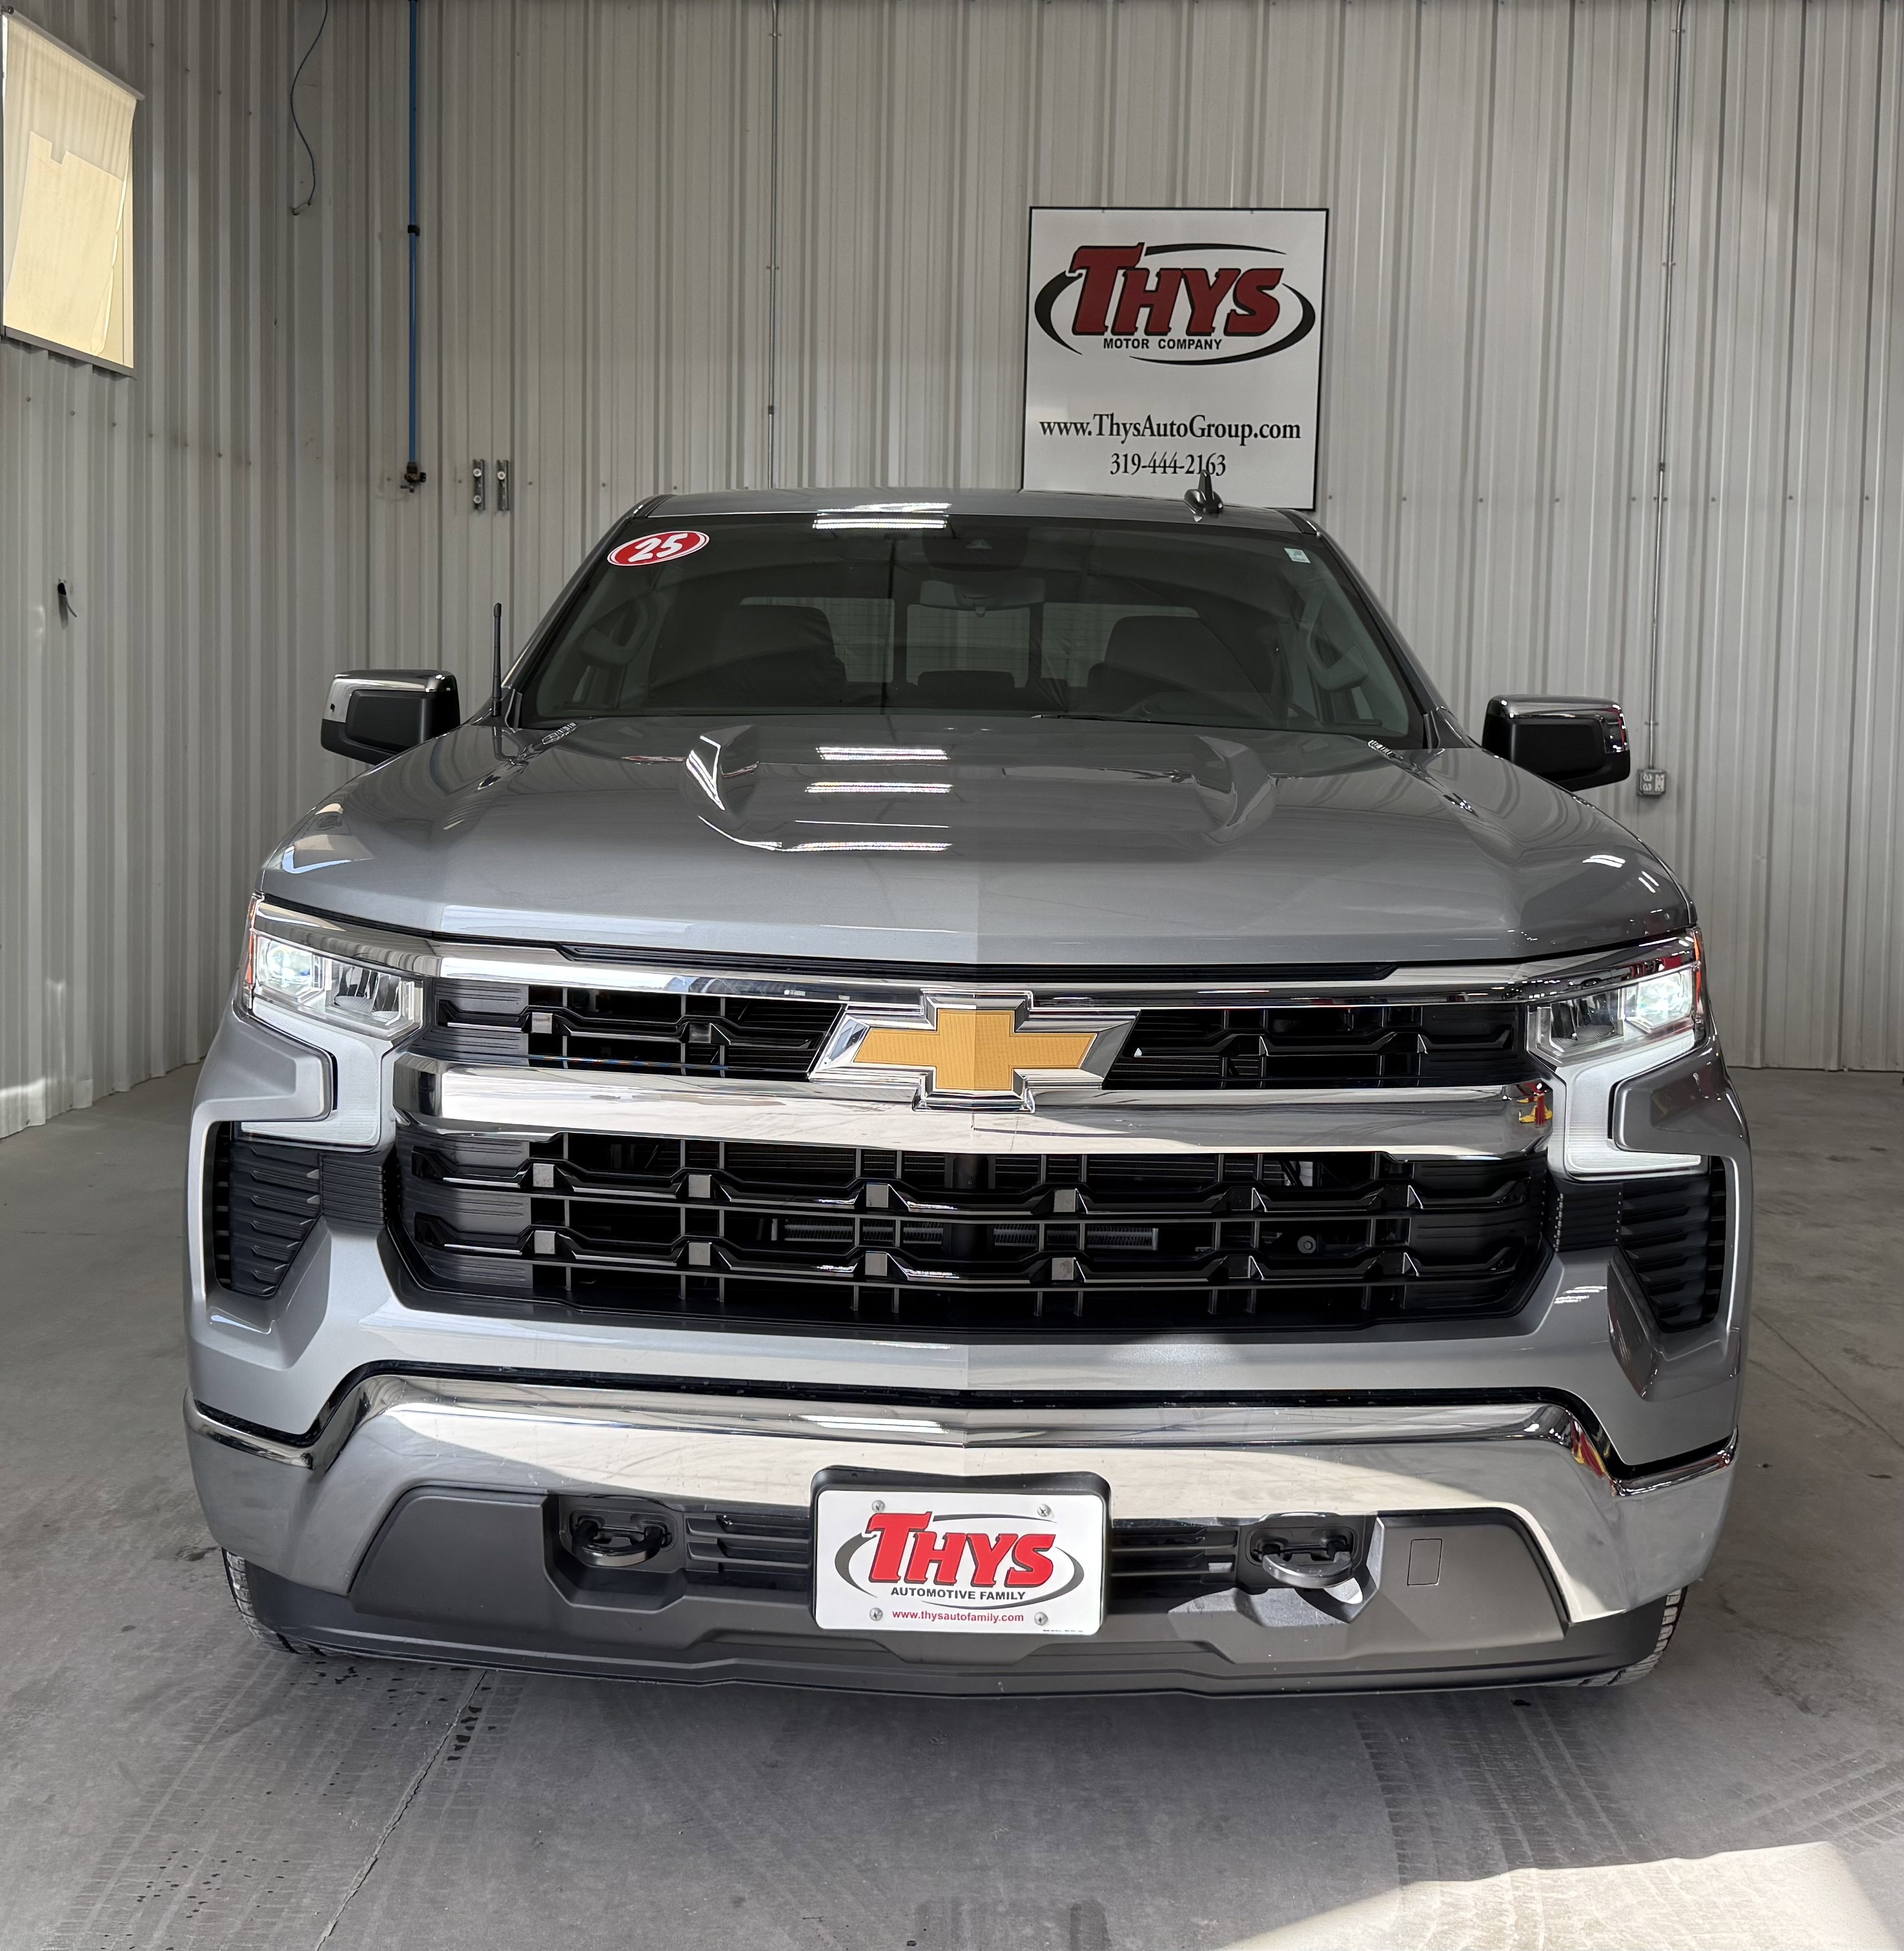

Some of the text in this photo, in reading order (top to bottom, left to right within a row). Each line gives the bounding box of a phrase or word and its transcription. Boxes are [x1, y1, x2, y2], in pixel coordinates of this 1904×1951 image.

[1070, 242, 1284, 337] THYS
[1103, 337, 1223, 350] MOTOR COMPANY
[1039, 413, 1301, 446] www.ThysAutoGroup.com
[1110, 451, 1227, 476] 319-444-2163
[627, 533, 688, 563] 25
[865, 1511, 1056, 1588] THYS
[890, 1587, 1026, 1601] AUTOMOTIVE FAMILY
[892, 1610, 1024, 1623] www.thysautofamily.com
